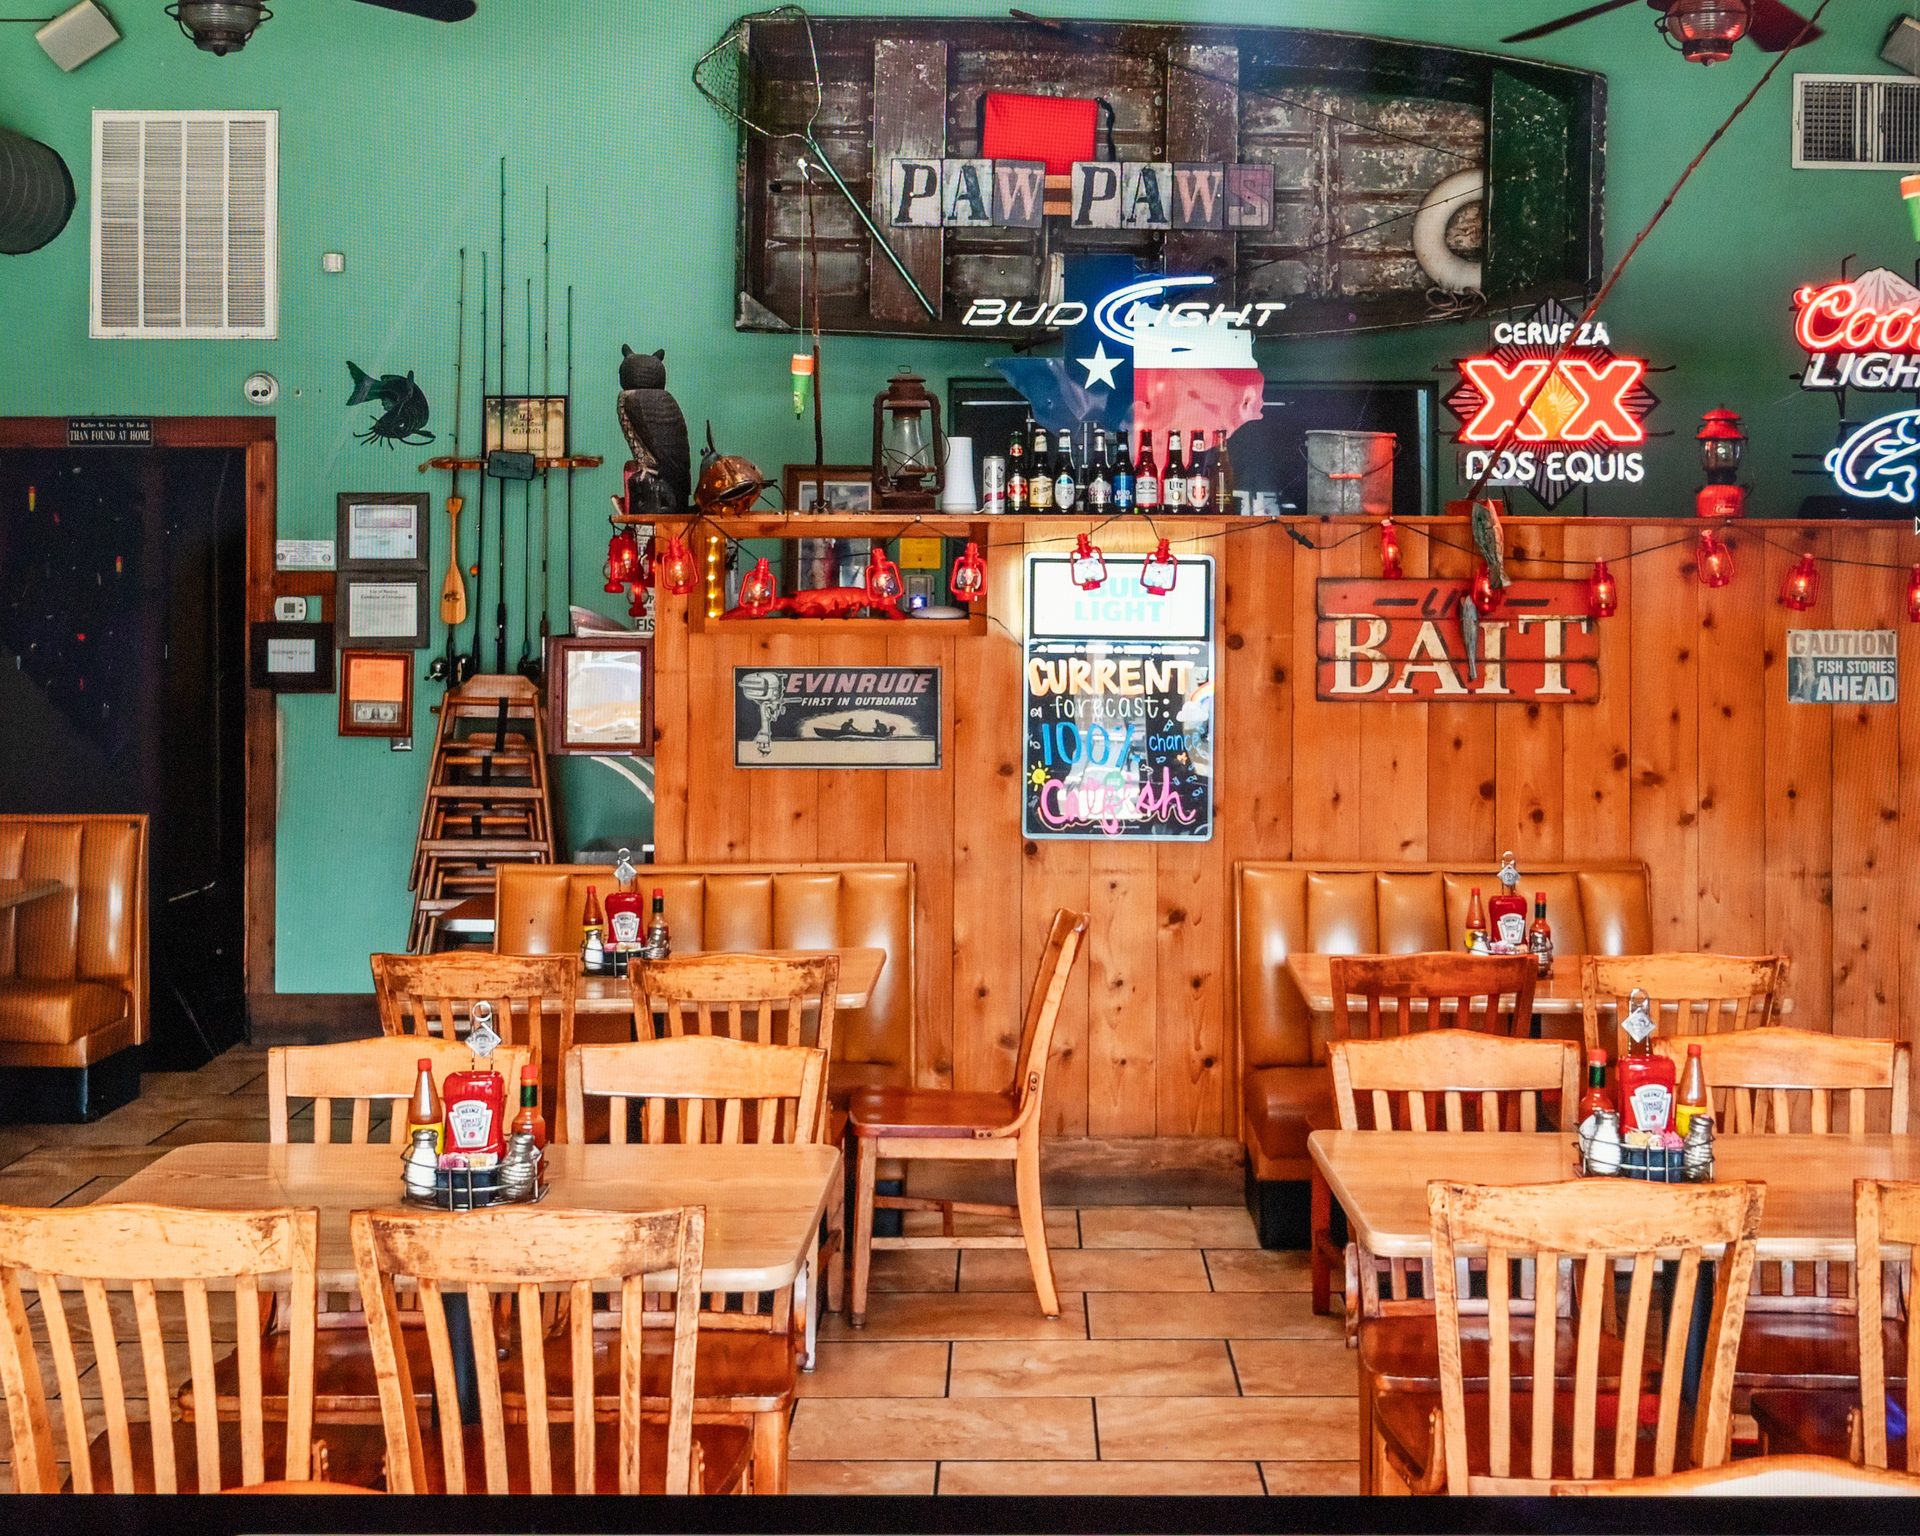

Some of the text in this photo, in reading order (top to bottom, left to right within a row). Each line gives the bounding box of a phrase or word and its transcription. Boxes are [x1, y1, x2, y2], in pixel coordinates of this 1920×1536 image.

[894, 163, 1271, 227] PAW PAWS
[962, 298, 1287, 328] BUD LIGHT
[1494, 322, 1610, 347] CERVEZA
[70, 430, 150, 441] THAN FOUND AT HOME
[1466, 450, 1645, 483] DOS EQUIS
[1074, 600, 1166, 623] LIGHT
[1324, 612, 1592, 695] BAIT
[1790, 633, 1895, 656] CAUTION
[1028, 656, 1198, 697] CURRENT
[1816, 660, 1895, 674] FISH STORIES
[785, 673, 933, 694] EVINRUDE
[1815, 675, 1896, 701] AHEAD
[801, 696, 919, 707] FIRST IN OUTBOARDS
[1050, 694, 1171, 719] forecast:
